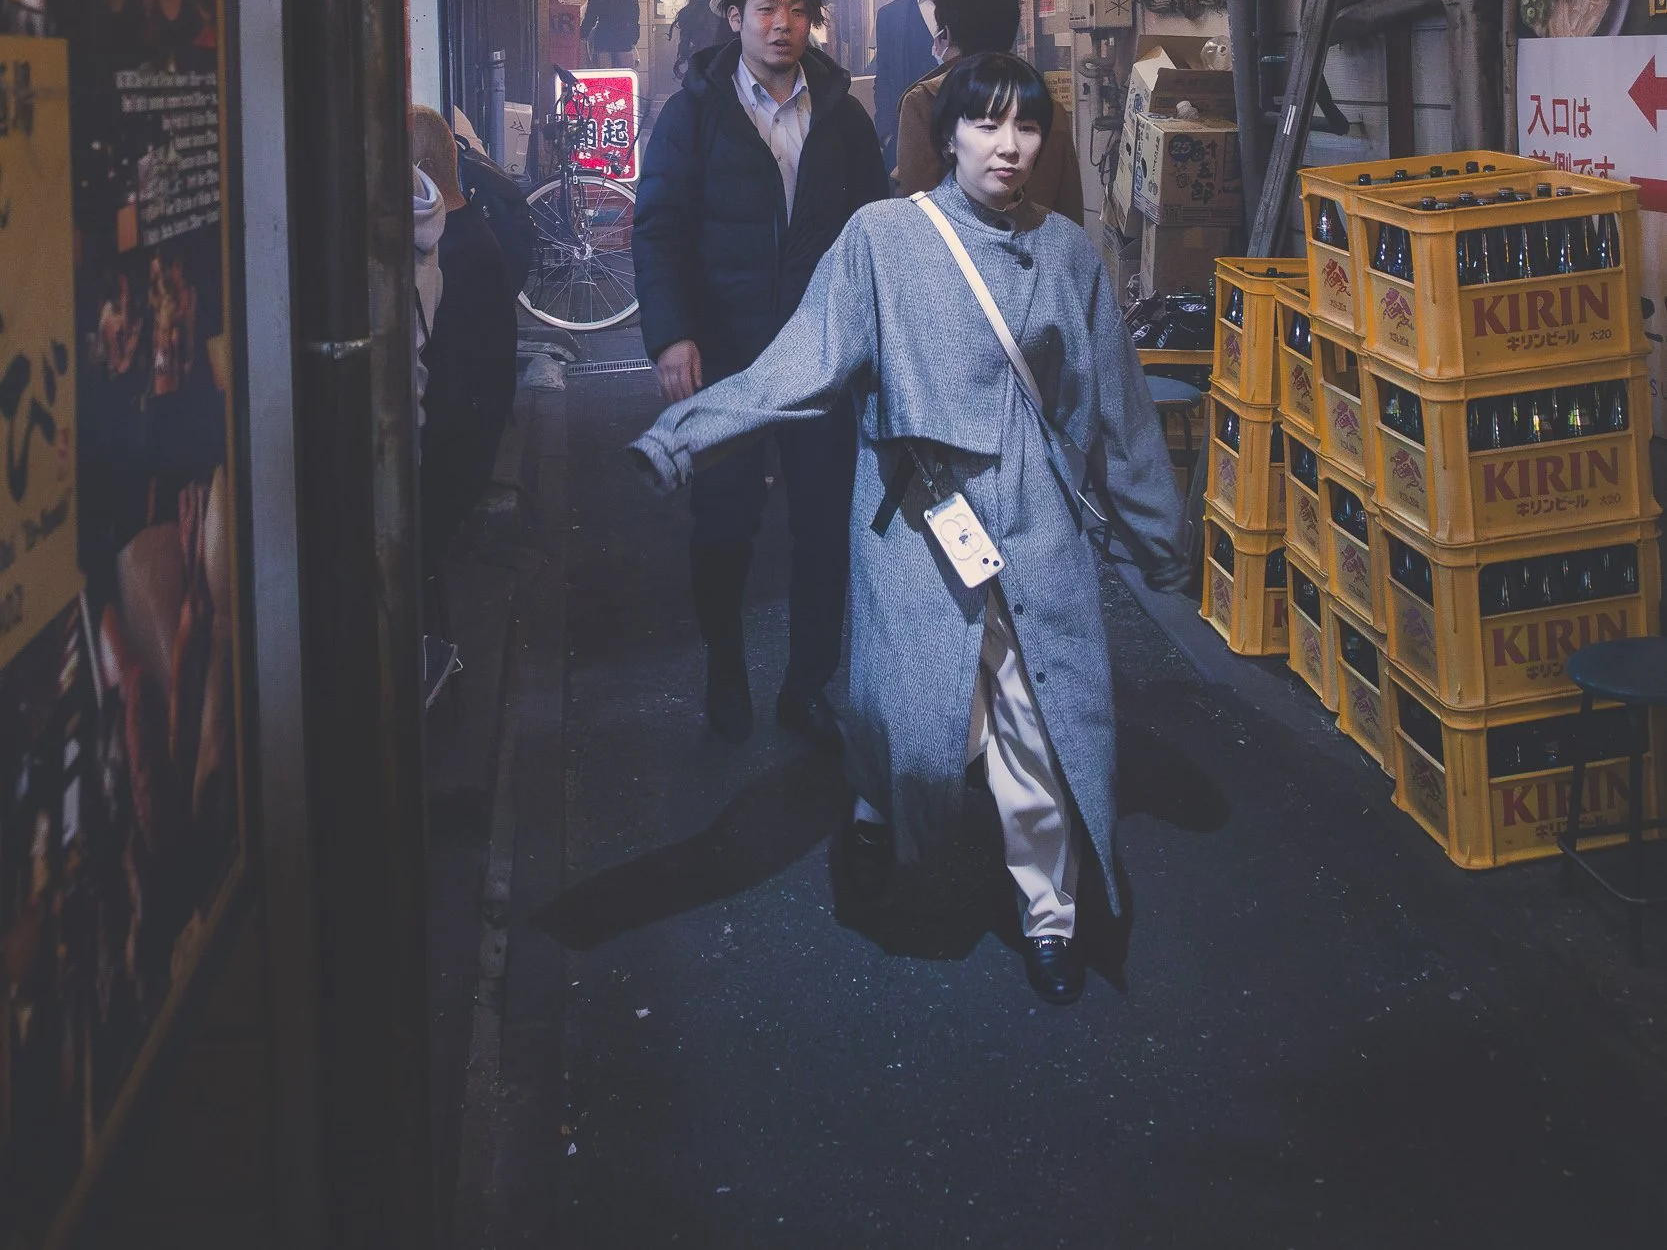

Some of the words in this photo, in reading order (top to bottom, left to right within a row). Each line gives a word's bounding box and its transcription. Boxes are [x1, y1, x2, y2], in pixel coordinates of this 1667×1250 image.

[1527, 95, 1592, 138] 入口は
[1473, 282, 1610, 338] KIRIN
[1507, 329, 1580, 352] キリンビール
[1482, 446, 1619, 504] KIRIN
[1516, 493, 1589, 517] キリンビール
[1492, 610, 1628, 667] KIRIN
